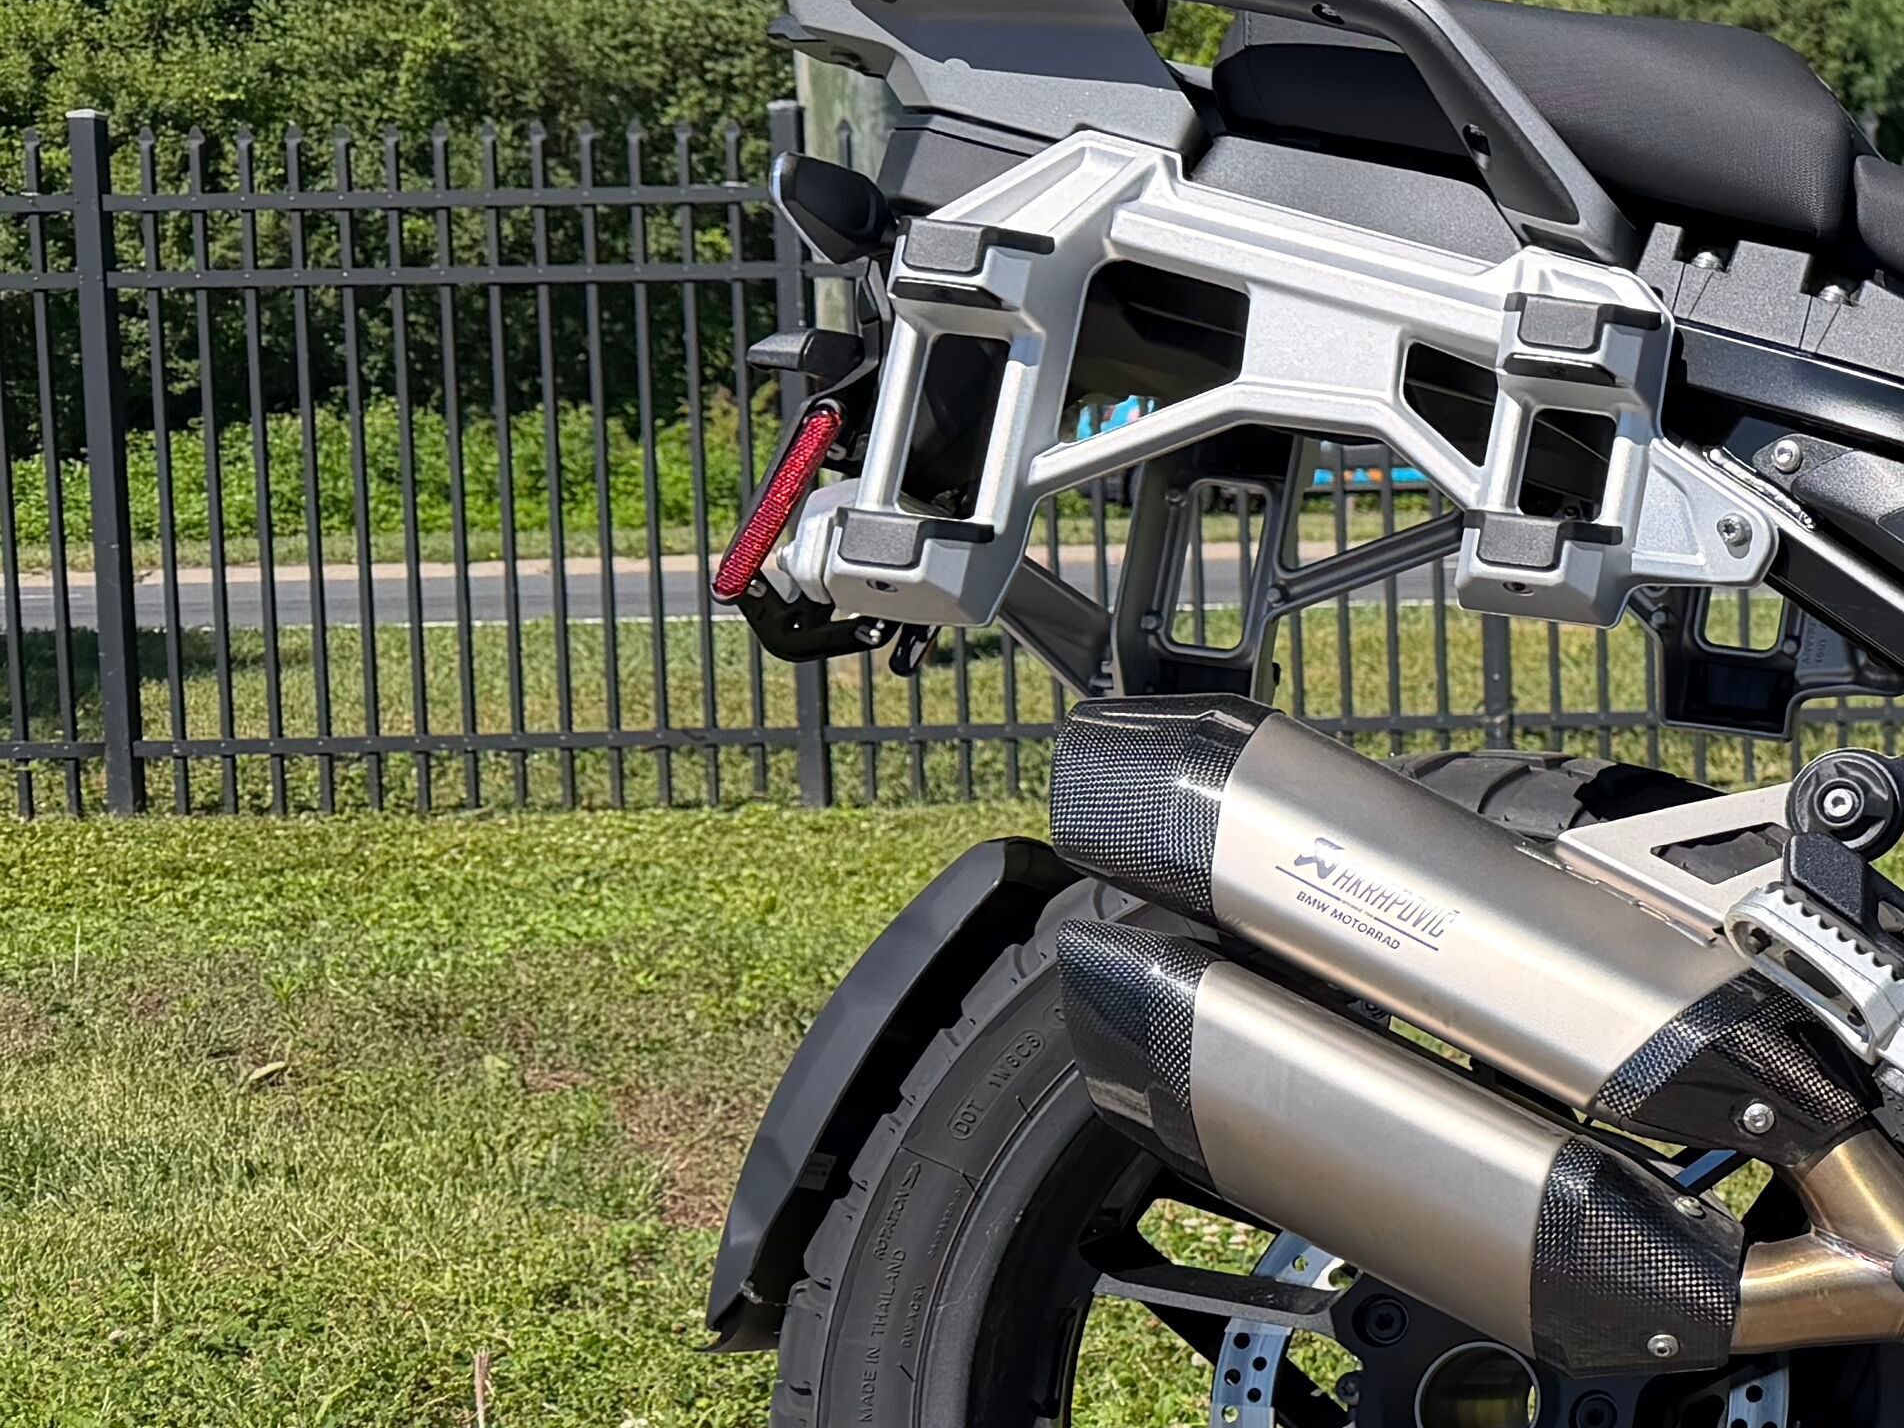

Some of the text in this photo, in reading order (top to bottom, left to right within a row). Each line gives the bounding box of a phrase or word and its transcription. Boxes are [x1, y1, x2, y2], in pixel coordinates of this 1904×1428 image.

[1297, 891, 1330, 913] BMW
[1330, 908, 1401, 950] MOTORRAD
[953, 1098, 984, 1136] DOT
[858, 1249, 907, 1423] MADE IN THAILAND
